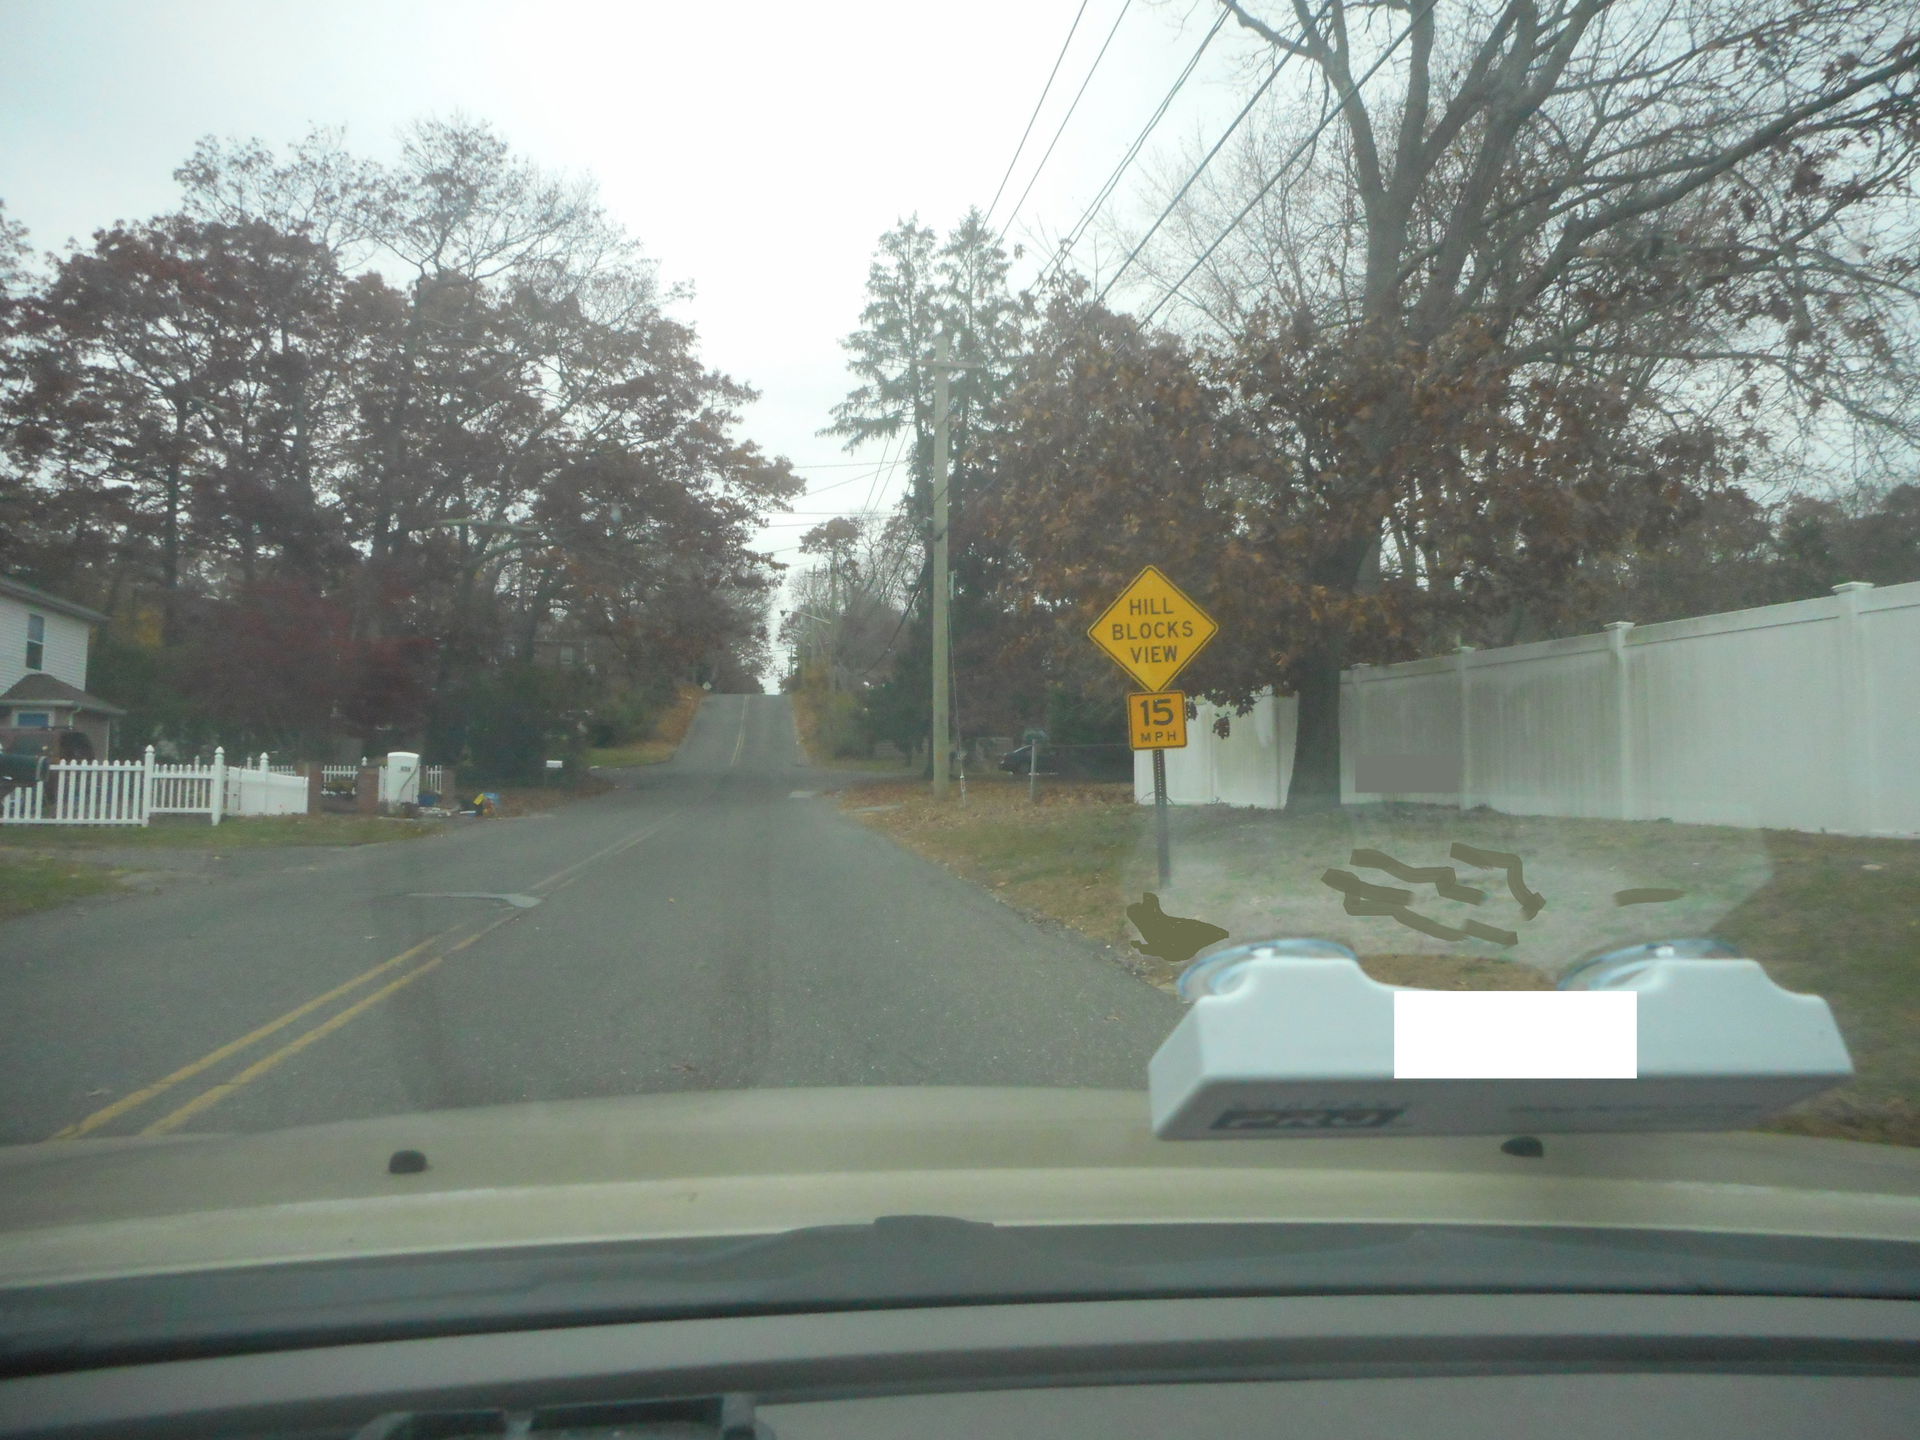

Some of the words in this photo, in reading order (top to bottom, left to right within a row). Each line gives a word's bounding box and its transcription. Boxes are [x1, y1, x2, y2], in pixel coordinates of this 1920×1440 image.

[1129, 597, 1175, 616] HILL
[1112, 620, 1194, 641] BLOCKS
[1130, 645, 1178, 664] VIEW
[1140, 698, 1175, 727] 15
[1140, 730, 1177, 743] MPH
